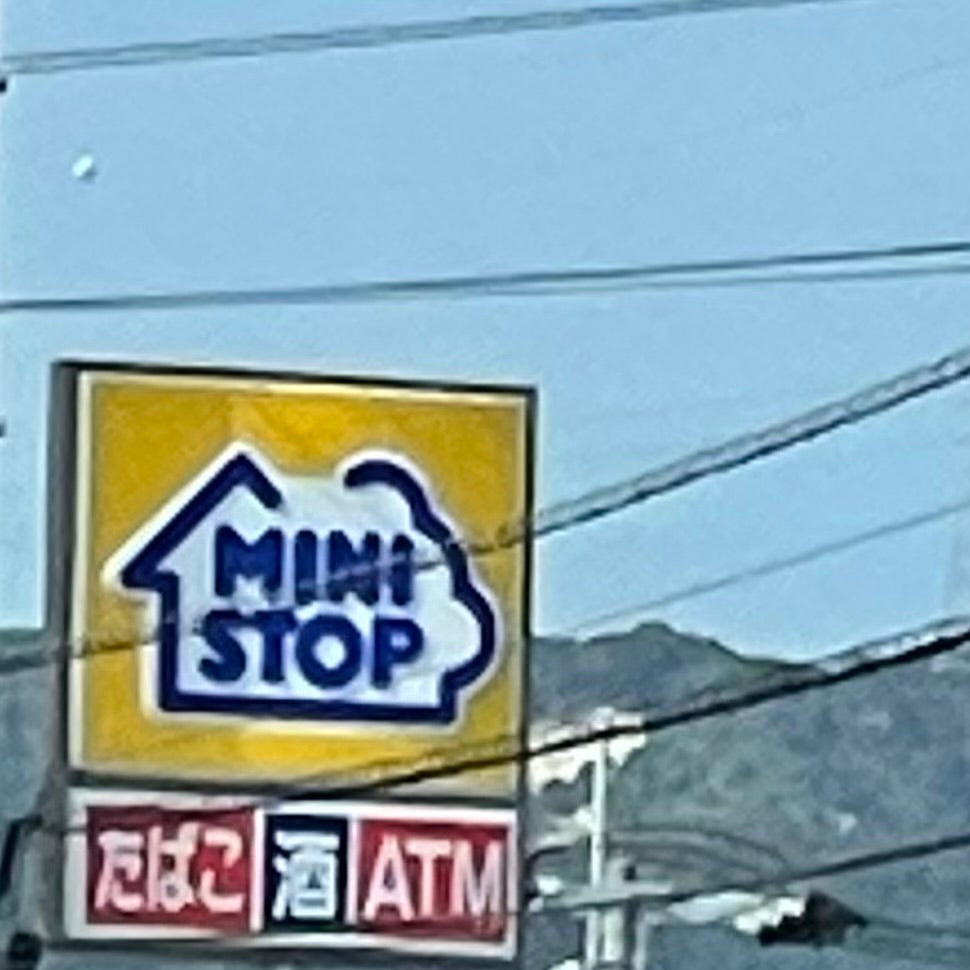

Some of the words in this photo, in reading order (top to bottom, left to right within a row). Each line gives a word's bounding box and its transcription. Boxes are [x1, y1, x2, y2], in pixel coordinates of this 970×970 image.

[214, 525, 415, 605] MINI
[199, 609, 424, 689] STOP
[94, 823, 246, 914] たばこ
[272, 829, 341, 921] 酒
[363, 834, 502, 929] ATM
